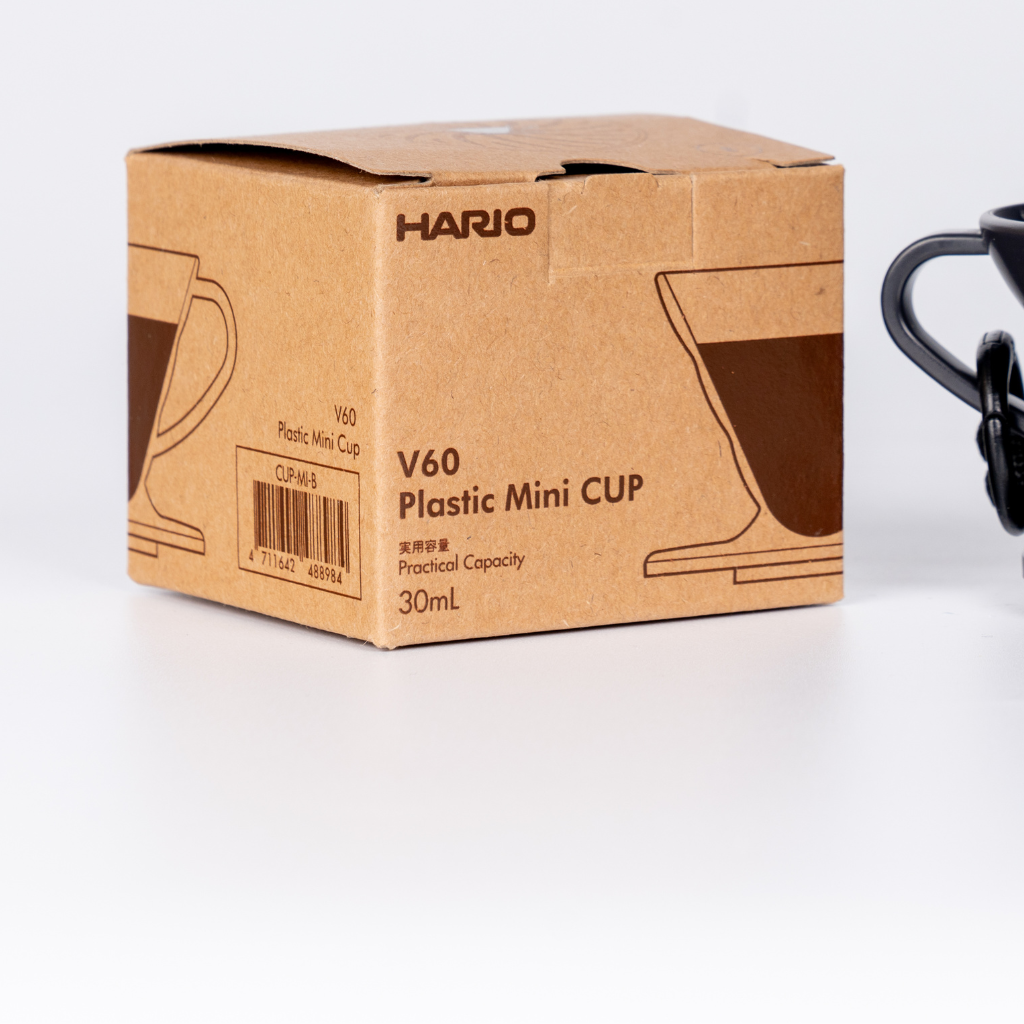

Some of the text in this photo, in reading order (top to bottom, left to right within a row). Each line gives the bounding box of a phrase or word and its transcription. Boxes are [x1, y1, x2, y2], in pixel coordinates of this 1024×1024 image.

[396, 206, 536, 240] HARIO
[334, 404, 357, 427] V60
[278, 420, 360, 460] Plastic Mini Cup
[275, 464, 317, 489] CUP-MI-B
[397, 447, 460, 478] V60
[399, 474, 644, 520] Plastic Mini CUP
[398, 538, 450, 555] 実用容量
[248, 549, 343, 585] 4 711642 488984
[398, 551, 526, 576] Practical Capacity
[398, 586, 460, 615] 30mL
